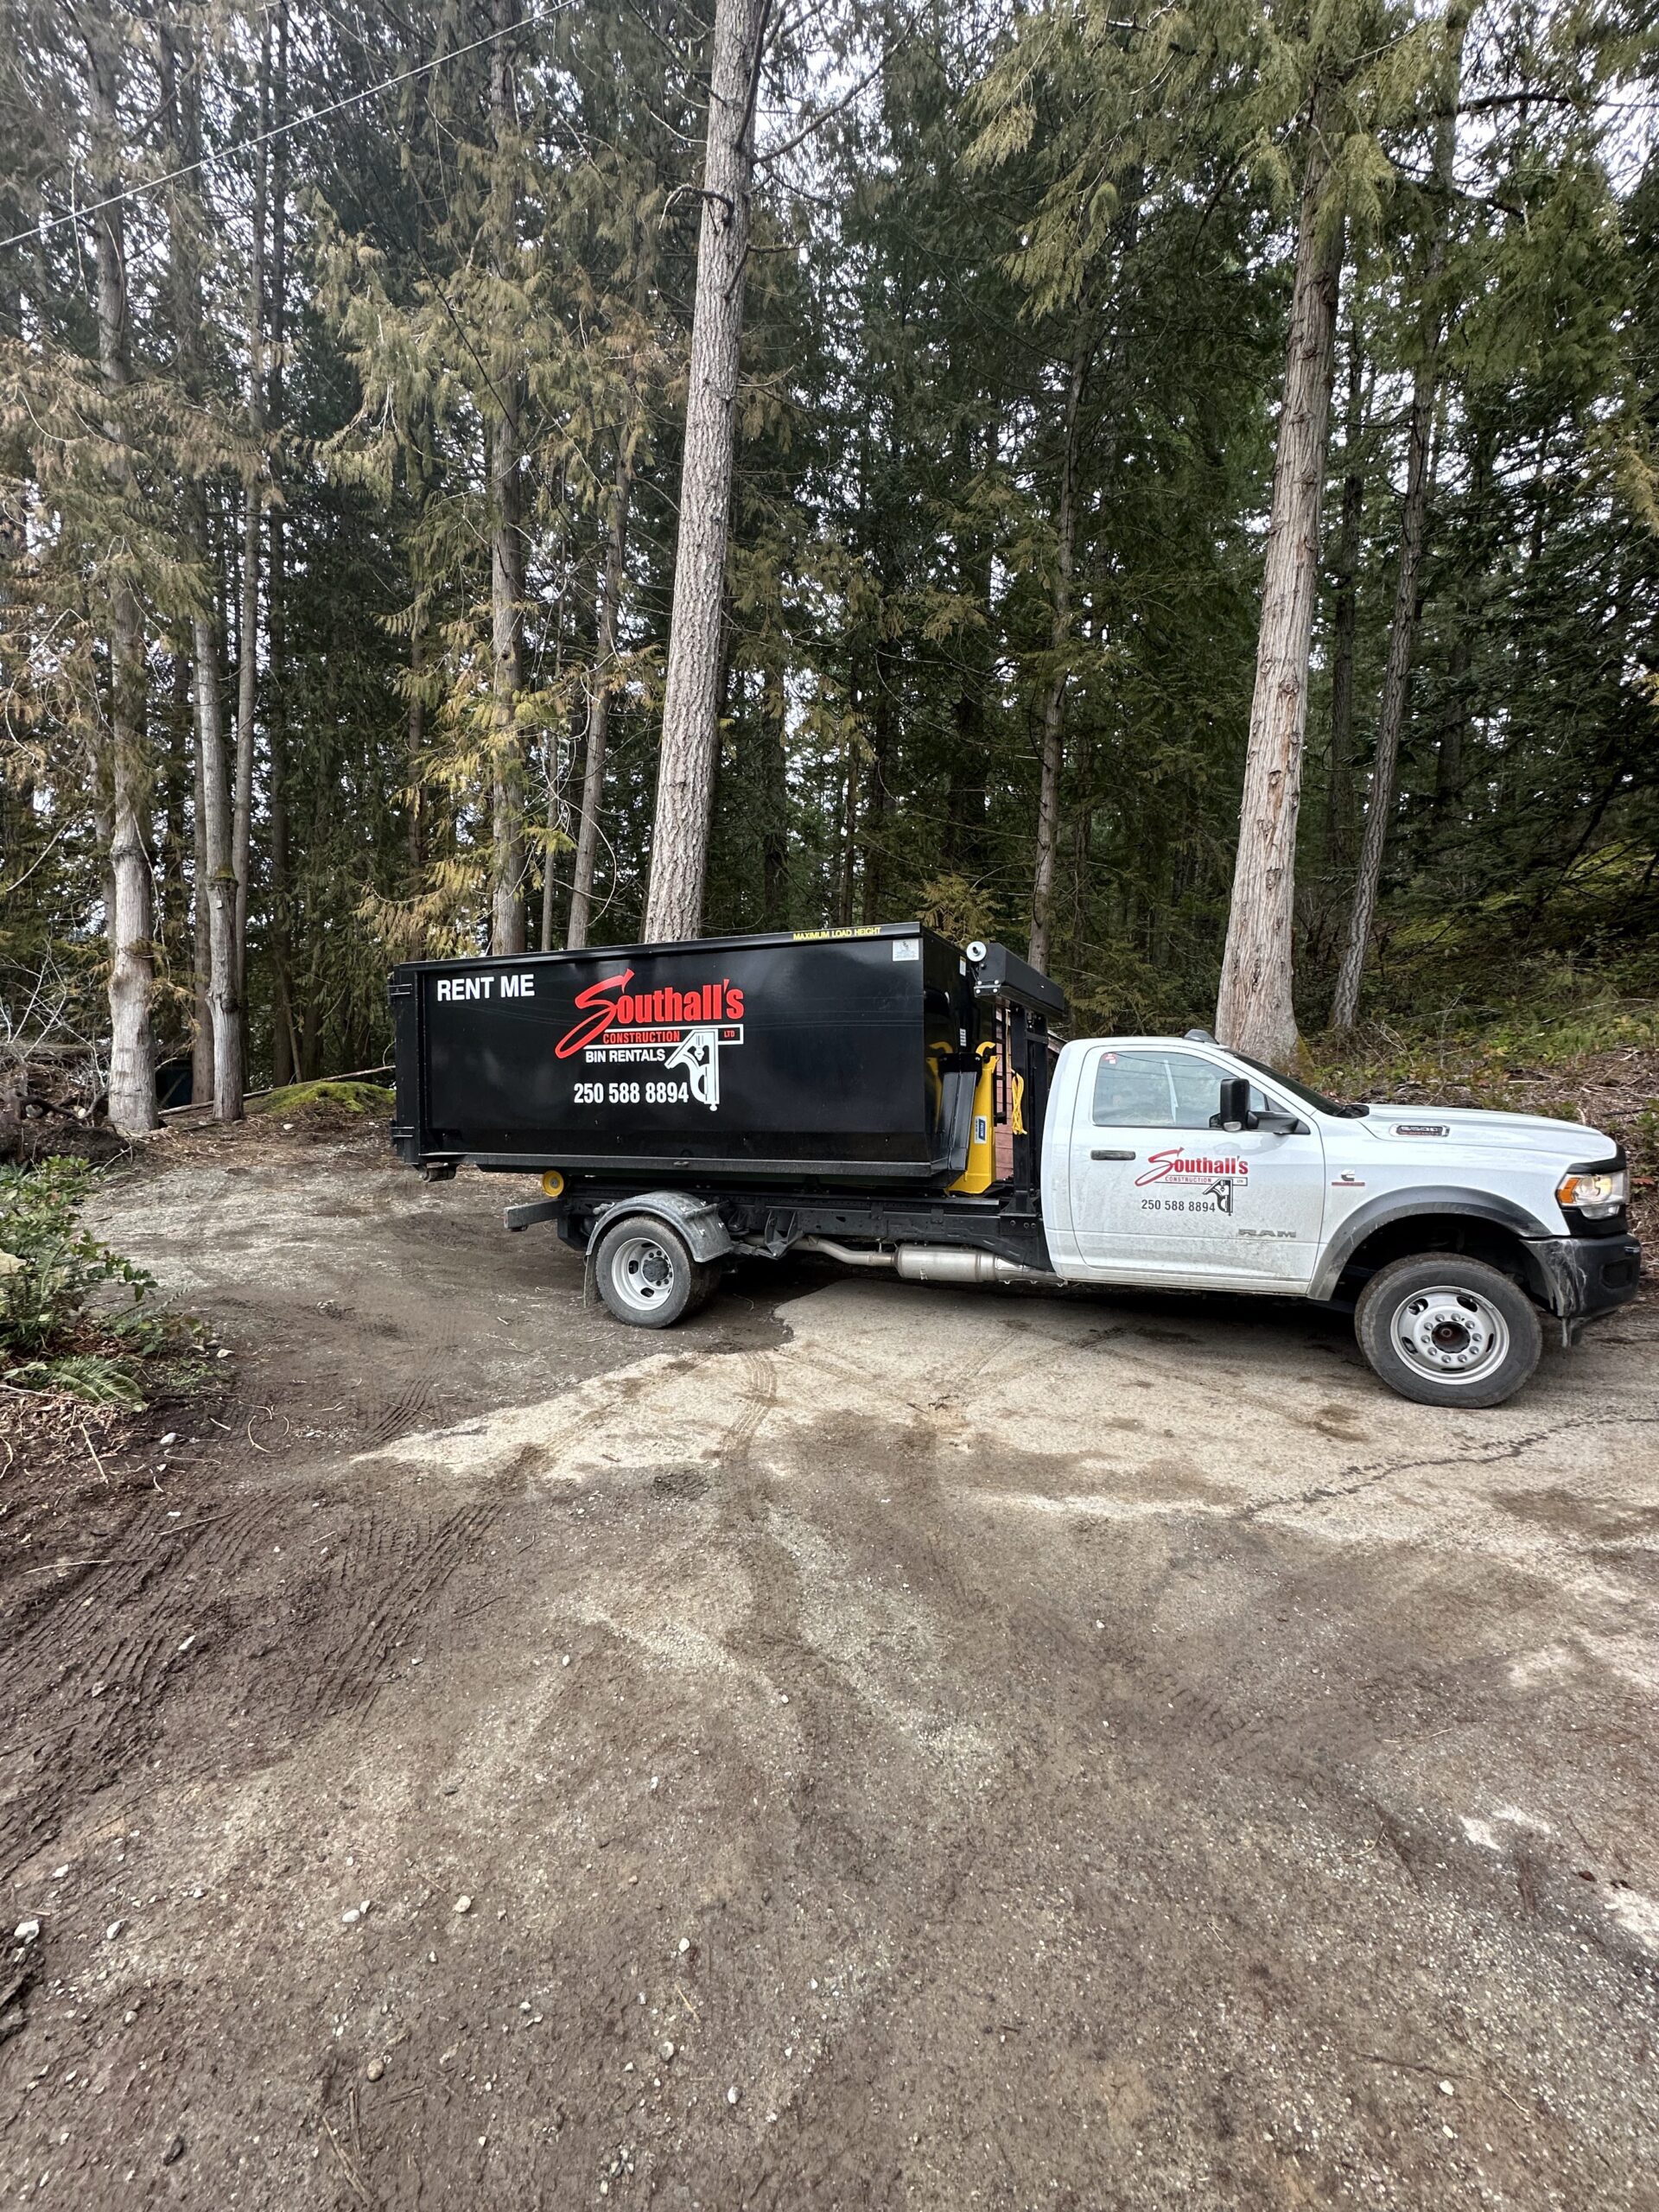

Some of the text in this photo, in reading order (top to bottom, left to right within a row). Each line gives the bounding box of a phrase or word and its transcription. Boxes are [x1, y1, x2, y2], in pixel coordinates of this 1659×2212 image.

[793, 926, 881, 941] MAXIMUM LOAD HEIGHT
[437, 974, 536, 1001] RENT ME
[555, 968, 745, 1058] Southall's
[602, 1030, 681, 1045] CONSTRUCTION
[585, 1048, 664, 1064] BIN RENTALS
[574, 1081, 690, 1103] 250 588 8894
[1135, 1147, 1249, 1186] Southall's
[1141, 1199, 1216, 1212] 250 588 8894
[1238, 1229, 1297, 1238] RAM
